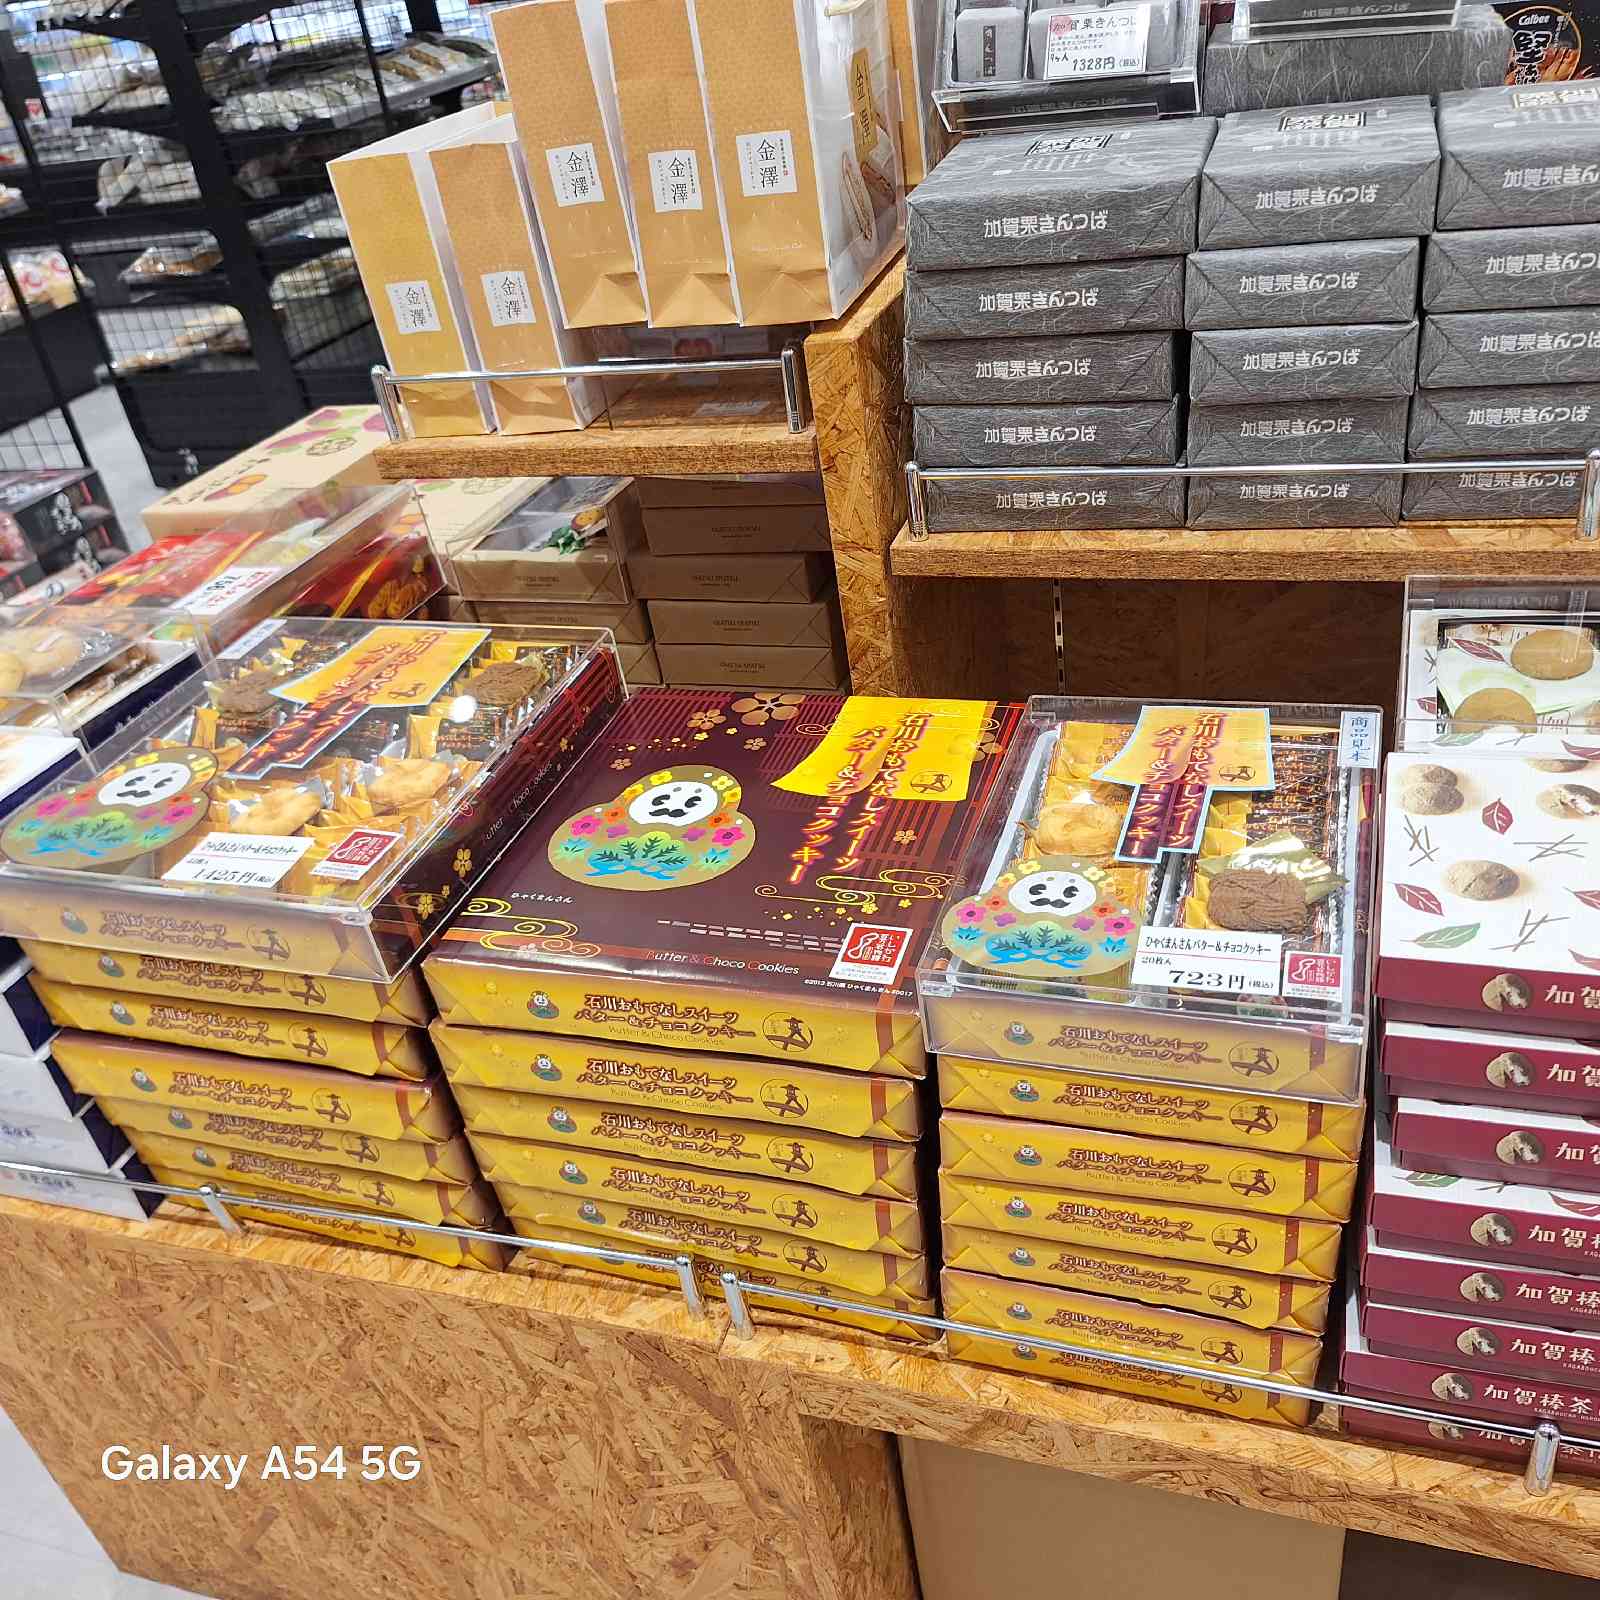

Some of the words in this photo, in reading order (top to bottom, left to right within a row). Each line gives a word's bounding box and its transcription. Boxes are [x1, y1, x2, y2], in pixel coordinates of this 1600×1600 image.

[1072, 56, 1116, 72] 1328円
[567, 151, 589, 198] 金澤
[757, 138, 779, 188] 金澤
[668, 156, 688, 204] 金澤
[1255, 184, 1379, 210] 加賀栗きんつば
[983, 209, 1109, 238] 加賀栗きんつば
[1486, 252, 1600, 275] 加賀栗きんつ
[1239, 272, 1360, 294] 加賀栗きんつば
[978, 287, 1099, 313] 加賀栗きんつば
[975, 358, 1092, 379] 加賀栗きんつば
[1243, 348, 1361, 371] 加賀栗きんつば
[1240, 417, 1355, 438] 加賀栗きんつば
[1466, 405, 1592, 425] 加賀栗きんつば
[984, 425, 1097, 444] 加賀栗きんつば
[1239, 483, 1351, 500] 加賀栗きんつば
[1458, 472, 1579, 488] 加賀栗きんつば
[996, 490, 1108, 509] 加賀栗きんつば
[833, 711, 935, 872] 石川おもてなしスイーツ
[1168, 711, 1228, 848] 石川おもてなしスイーツ
[788, 725, 889, 885] バター&チョコクッキー
[646, 951, 689, 963] Butter
[703, 956, 746, 969] Choco
[747, 960, 800, 975] Cookies
[1168, 969, 1246, 990] 723円
[584, 993, 740, 1024] 石川おもてなしスイーツ
[574, 1009, 757, 1039] バター&チョコクッキー
[1060, 1024, 1209, 1052] 石川おもてなしスイーツ
[586, 1057, 738, 1089] 石川おもてなしスイーツ
[576, 1072, 755, 1104] バター&チョコクッキー
[1065, 1083, 1210, 1110] 石川おもてなしスイーツ
[600, 1112, 746, 1146] 石川おもてなしスイーツ
[1067, 1148, 1209, 1173] 石川おもてなしスイーツ
[1056, 1201, 1194, 1231] 石川おもてなしスイーツ
